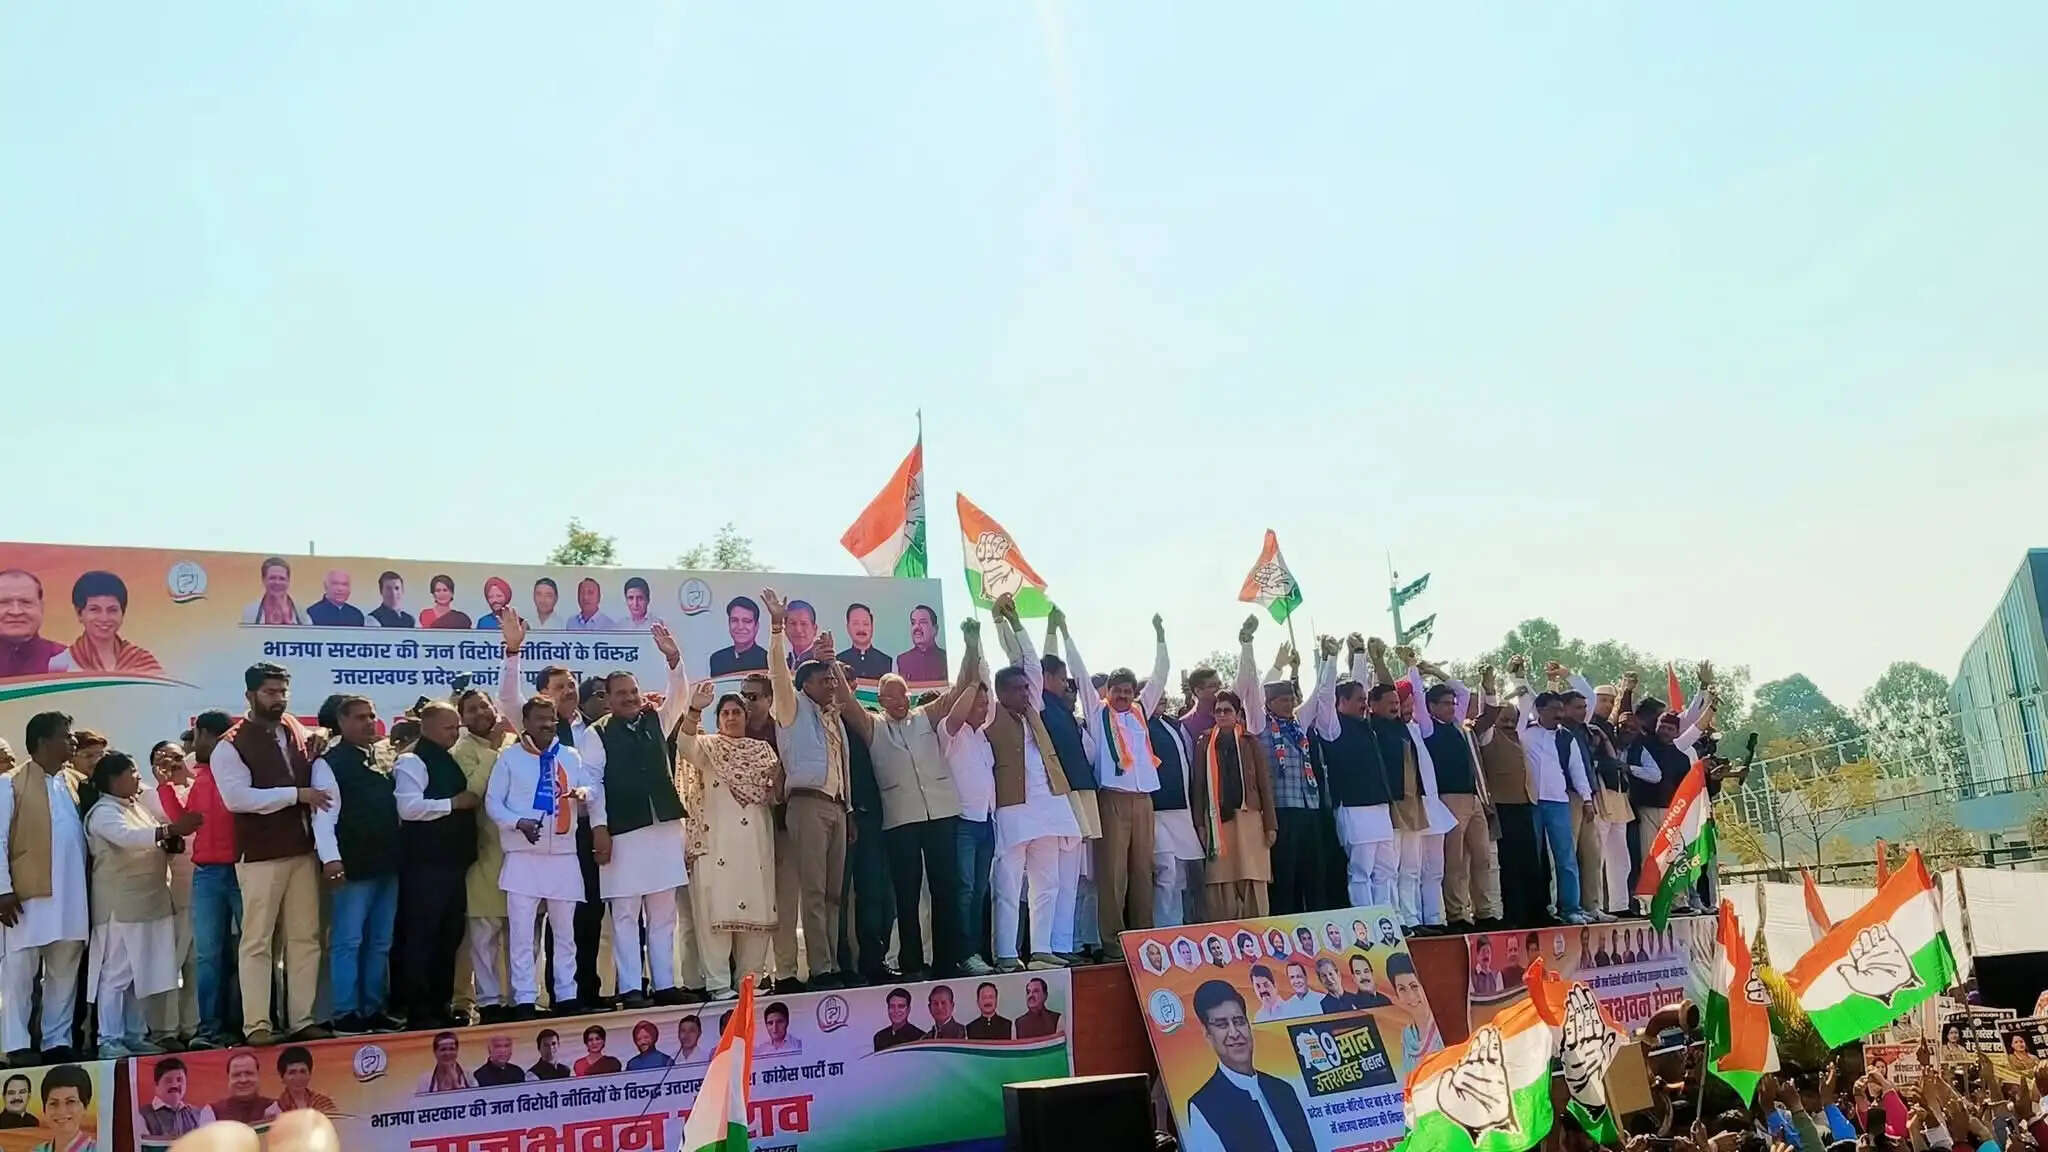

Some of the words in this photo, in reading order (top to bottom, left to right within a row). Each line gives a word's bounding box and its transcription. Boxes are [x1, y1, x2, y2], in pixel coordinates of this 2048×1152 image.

[263, 641, 323, 658] भाजपा
[327, 642, 392, 659] सरकार
[394, 639, 420, 659] की
[421, 644, 455, 660] जन
[573, 642, 590, 660] के
[592, 643, 639, 663] विरुद्ध
[331, 669, 418, 685] उत्तराखण्ड
[1320, 1032, 1341, 1066] 9
[1335, 1026, 1375, 1058] साल
[1359, 1053, 1386, 1071] बेहाल
[371, 1110, 414, 1128] भाजपा
[418, 1104, 466, 1124] सरकार
[468, 1099, 487, 1118] की
[489, 1100, 514, 1115] जन
[516, 1091, 558, 1113] विरोधी
[561, 1086, 607, 1108] नीतियों
[608, 1085, 622, 1101] के
[624, 1082, 662, 1100] विरुद्ध
[762, 1065, 799, 1085] कांग्रेस
[802, 1060, 826, 1078] पार्टी
[828, 1062, 844, 1076] का
